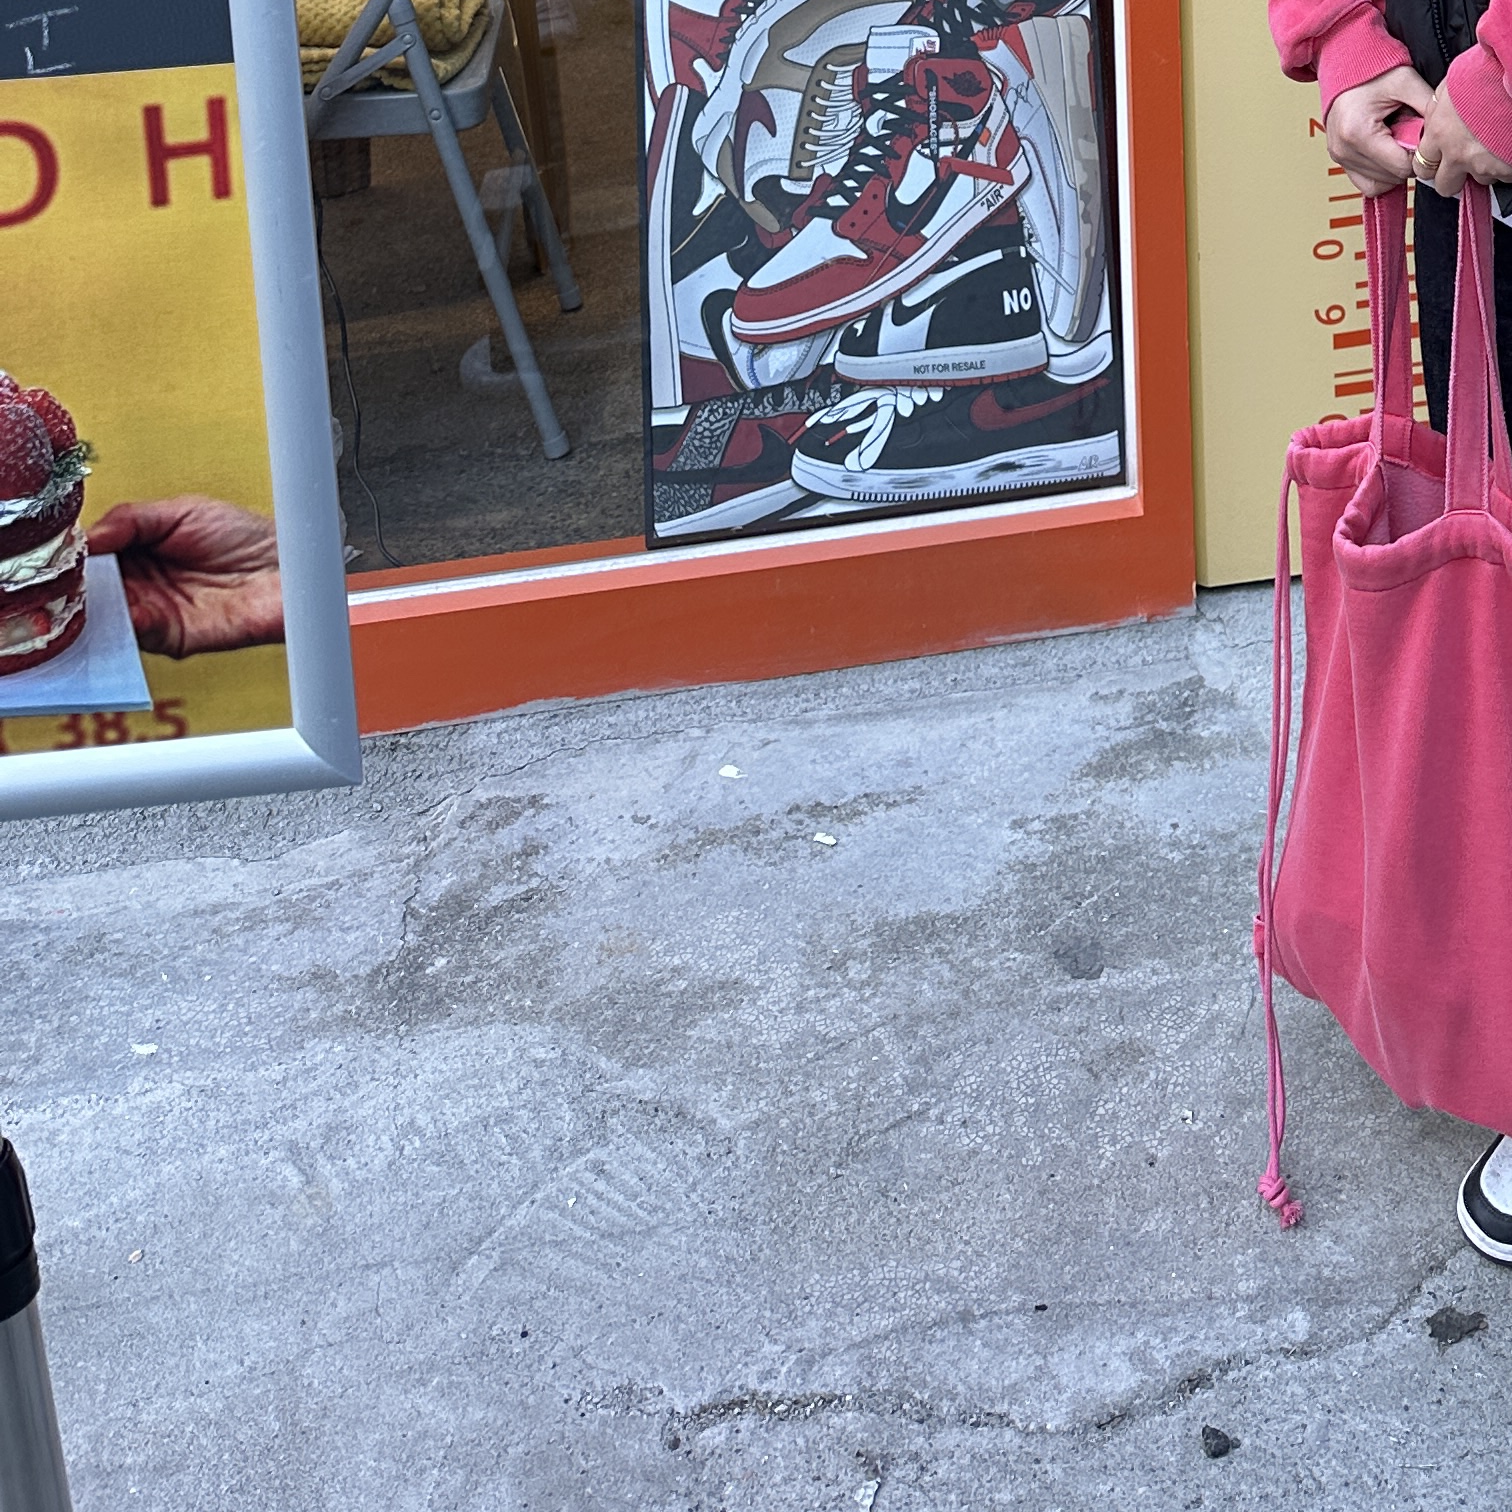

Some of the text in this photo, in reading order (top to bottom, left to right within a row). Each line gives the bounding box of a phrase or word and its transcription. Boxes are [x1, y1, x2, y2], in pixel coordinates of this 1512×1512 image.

[1002, 287, 1032, 316] NO
[913, 359, 986, 375] NOT FOR RESALE
